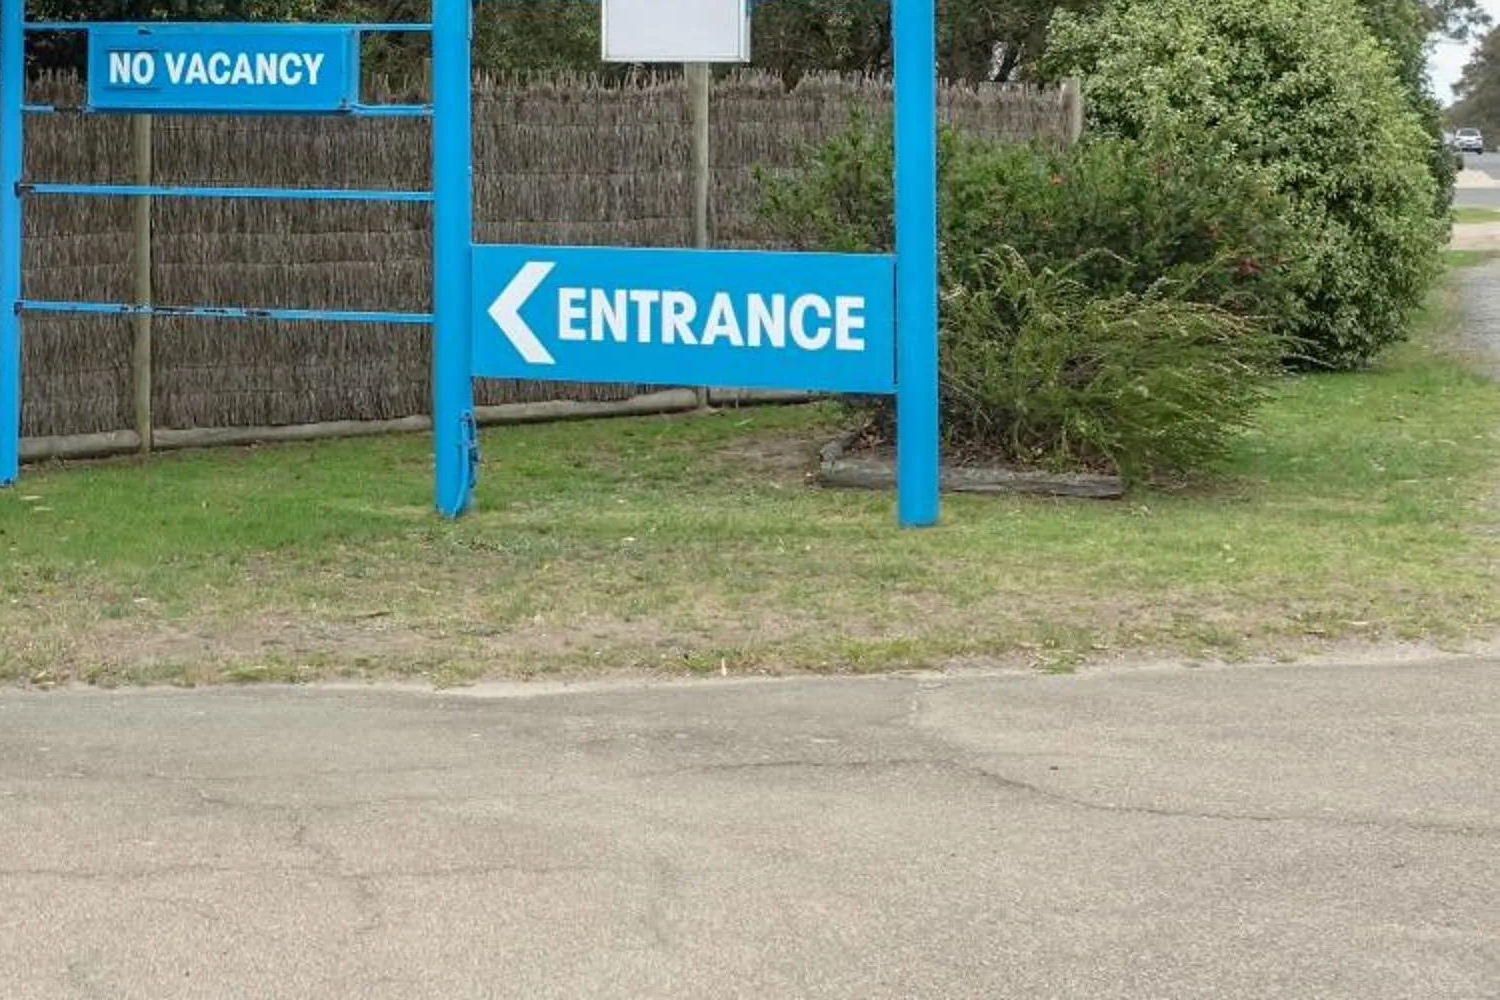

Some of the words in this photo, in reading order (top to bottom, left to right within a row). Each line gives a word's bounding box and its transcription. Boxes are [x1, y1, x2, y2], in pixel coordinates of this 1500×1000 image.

[108, 51, 156, 85] NO
[164, 51, 325, 86] VACANCY
[557, 287, 866, 352] ENTRANCE
